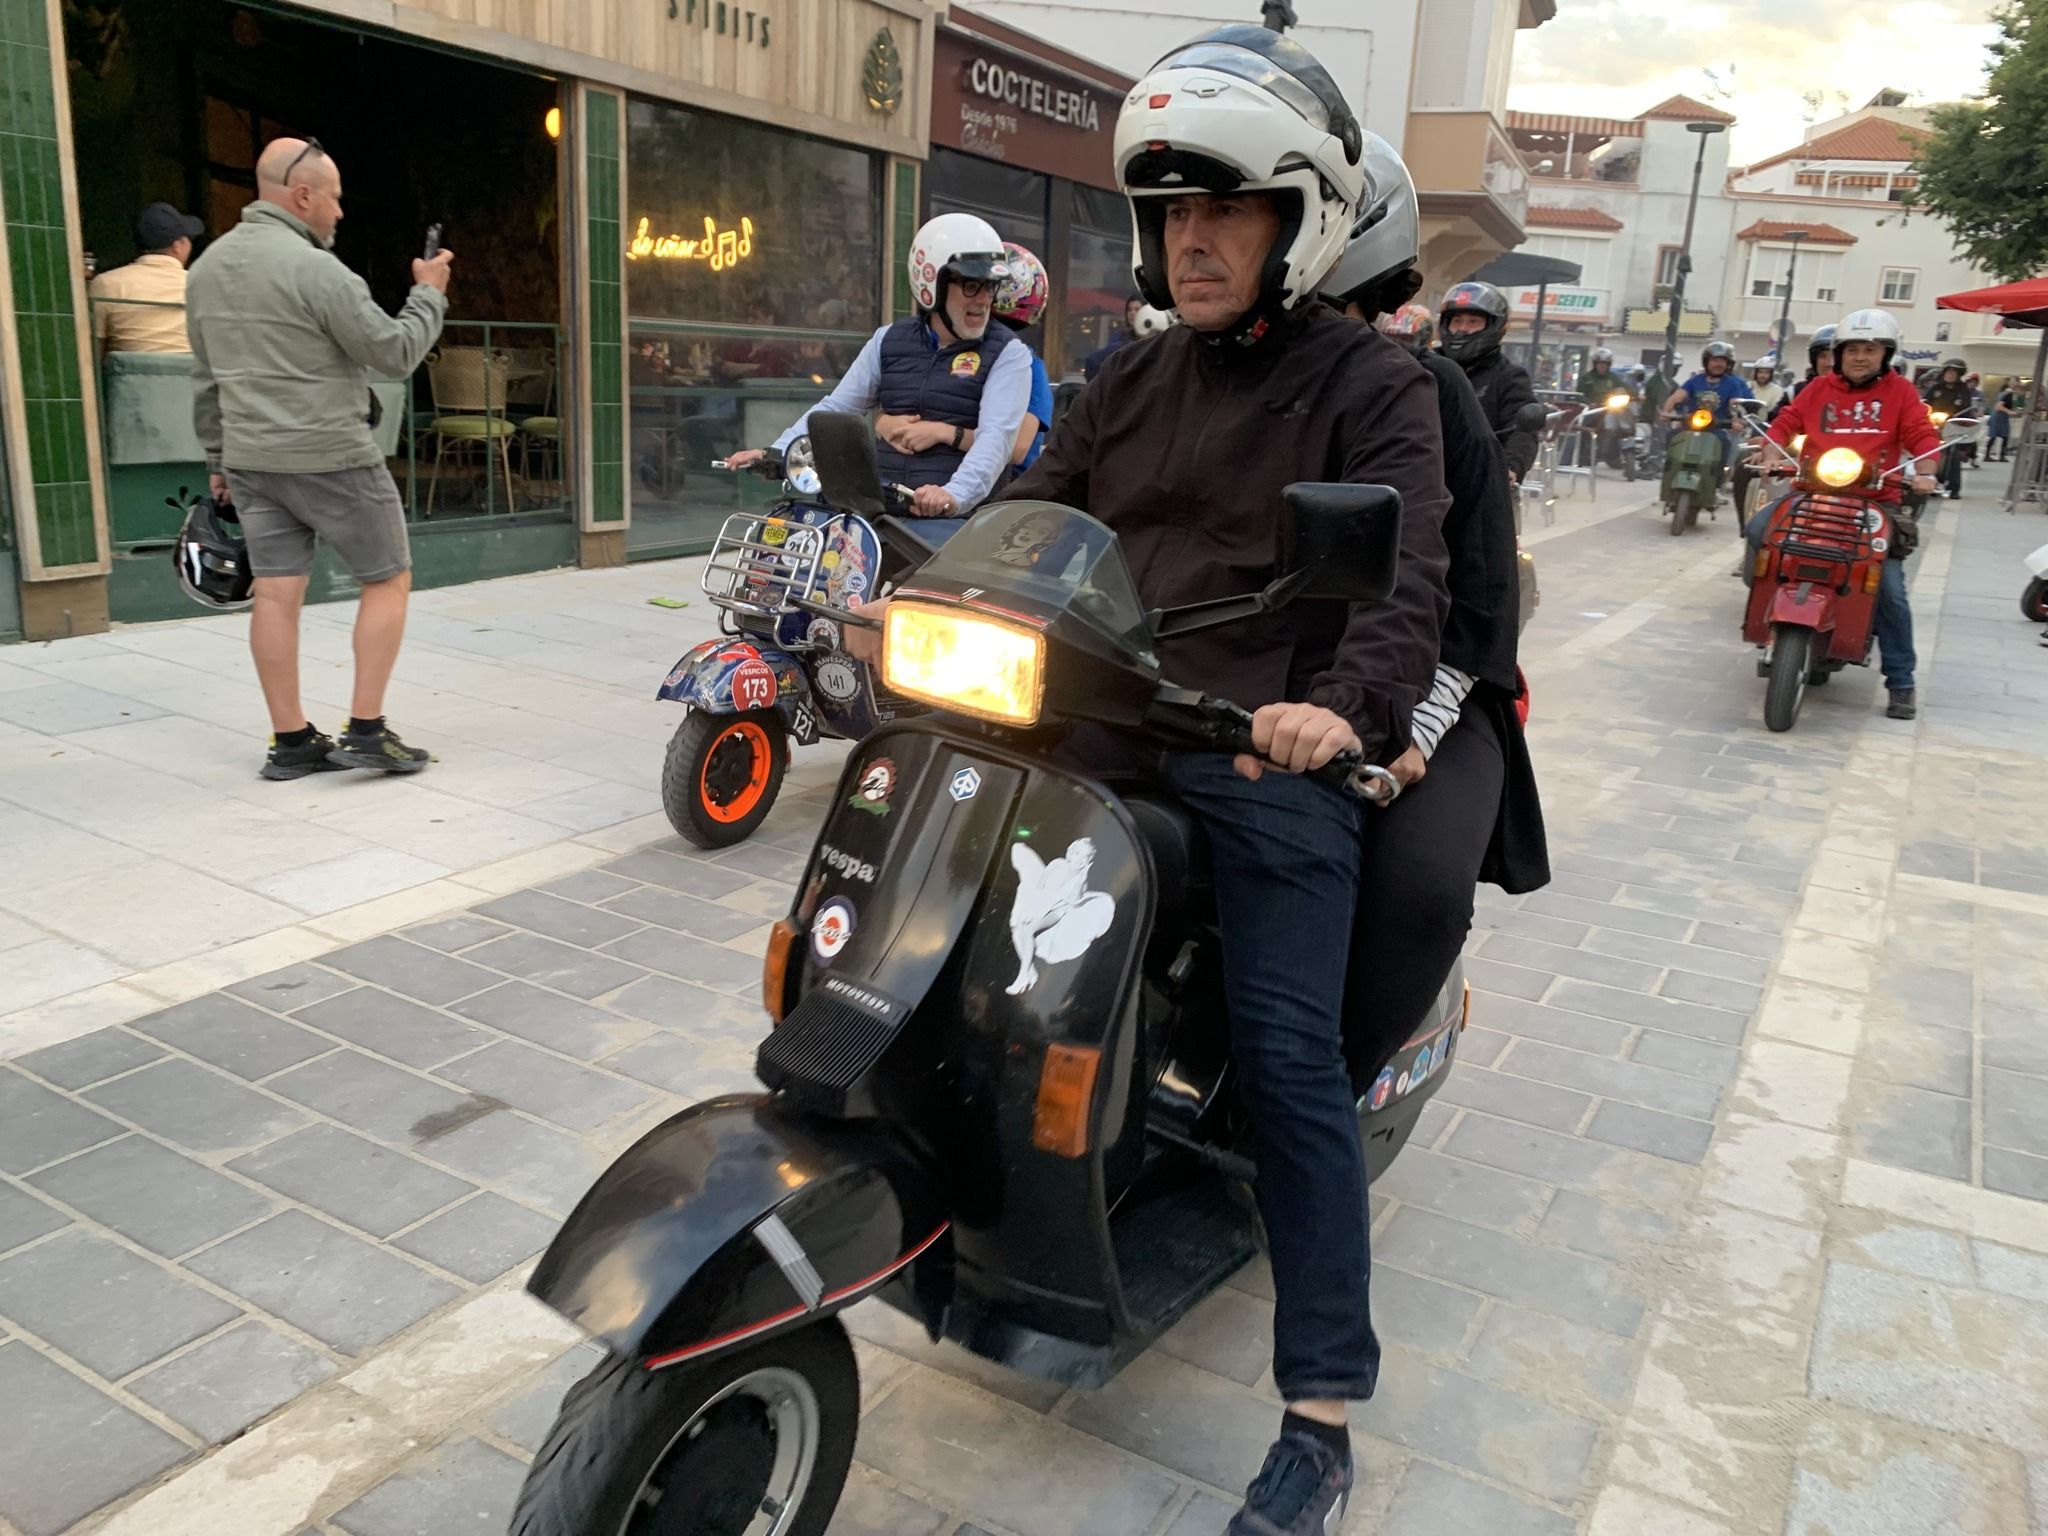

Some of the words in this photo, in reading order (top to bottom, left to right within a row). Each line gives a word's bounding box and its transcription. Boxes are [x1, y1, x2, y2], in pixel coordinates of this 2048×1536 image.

[668, 0, 770, 48] SPIRITS
[971, 58, 1099, 132] COCTELERÍA
[961, 103, 993, 128] Desde
[1519, 291, 1598, 308] MECACENTRO
[739, 667, 769, 676] VESPICOS
[814, 656, 857, 673] TRAVESPERA
[743, 678, 768, 699] 173
[827, 674, 846, 690] 141
[792, 708, 813, 741] 121
[820, 843, 875, 884] vespa
[825, 978, 891, 1014] MOTOVESPA
